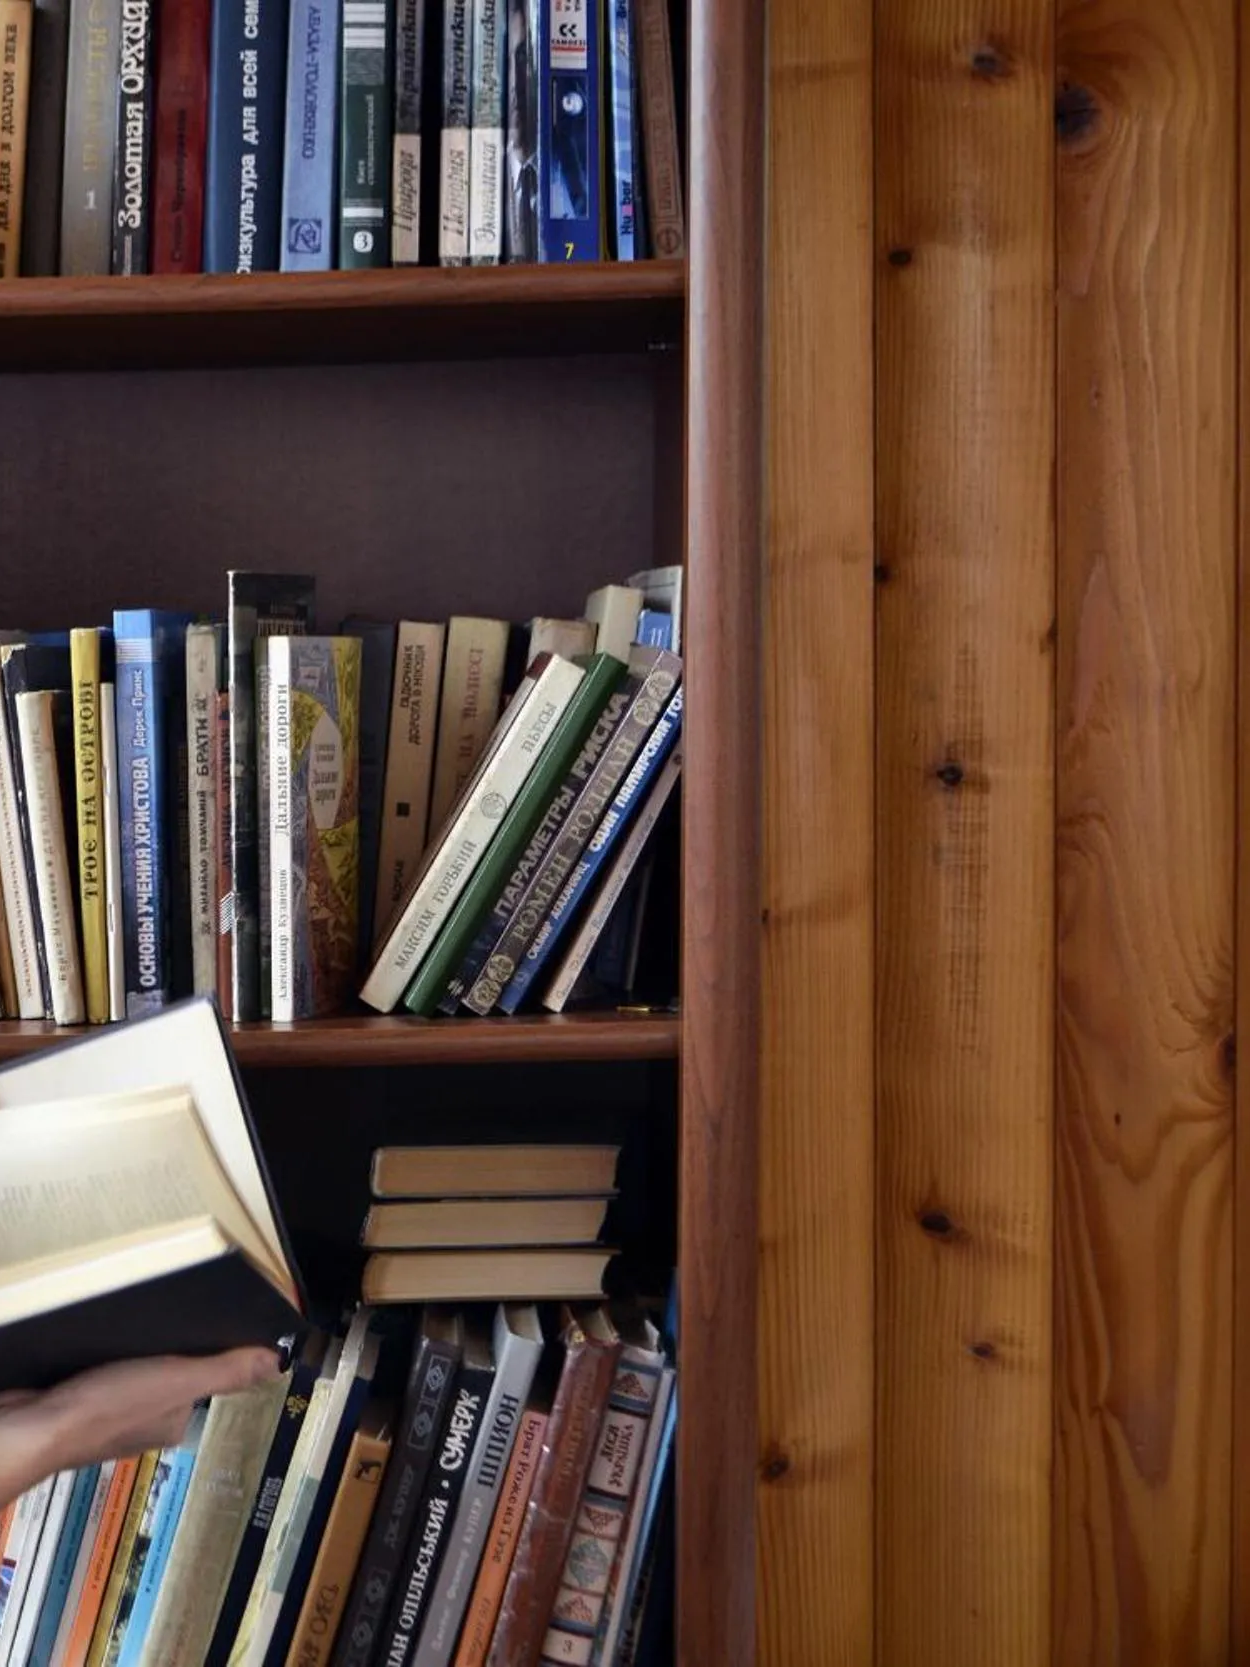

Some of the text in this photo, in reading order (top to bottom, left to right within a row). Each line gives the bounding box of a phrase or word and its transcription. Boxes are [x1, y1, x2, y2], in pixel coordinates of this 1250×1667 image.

[238, 48, 259, 98] всей
[240, 105, 260, 145] для
[129, 756, 154, 845] ХРИСТОВА
[493, 785, 576, 919] ПАРАМЕТРЫ
[570, 688, 629, 780] РИСКА
[133, 847, 156, 914] УЧЕНИЯ
[136, 916, 158, 987] ОСНОВЫ
[394, 908, 436, 969] МАКСИМ
[474, 1390, 522, 1489] ШПИОН
